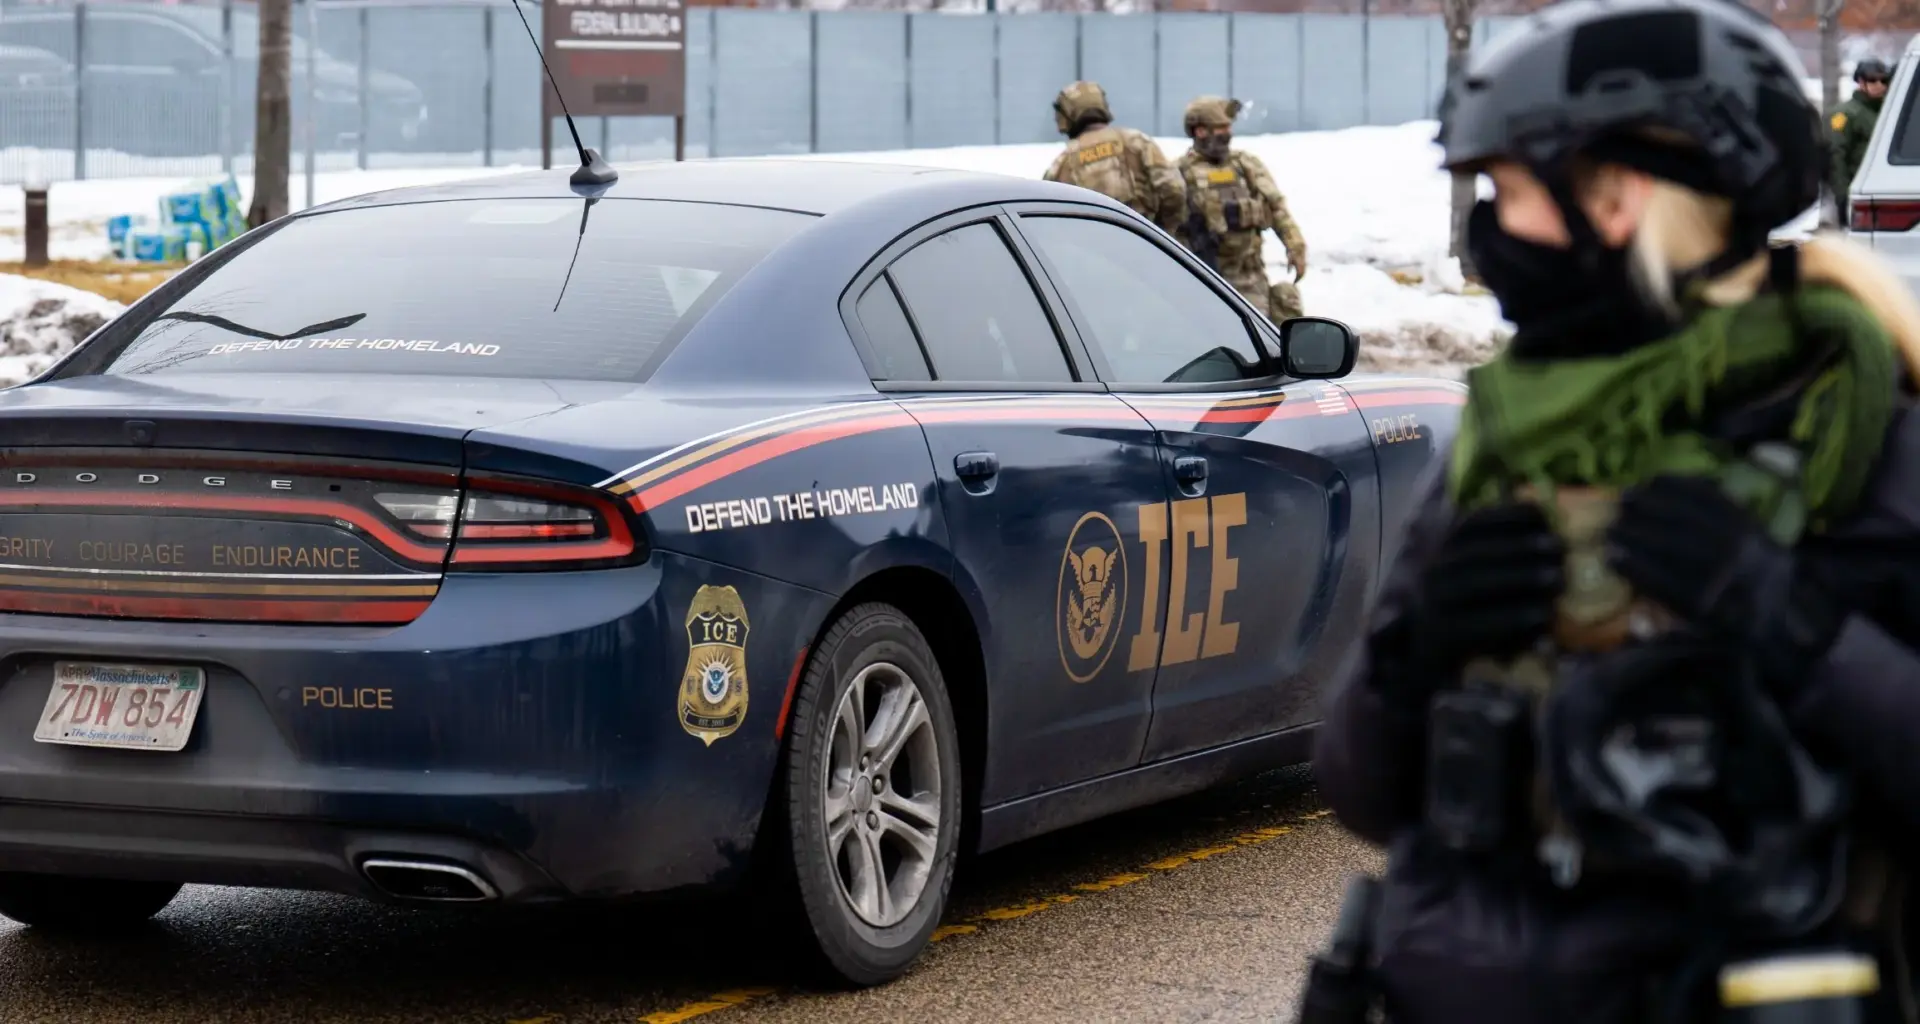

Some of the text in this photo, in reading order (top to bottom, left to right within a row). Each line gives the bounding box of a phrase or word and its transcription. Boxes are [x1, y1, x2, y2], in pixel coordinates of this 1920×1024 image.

[208, 338, 500, 356] DEFEND THE HOMELAND
[1371, 413, 1421, 446] POLICE
[17, 472, 293, 490] DODGE
[685, 482, 919, 533] DEFEND THE HOMELAND
[79, 541, 185, 564] COURAGE
[212, 545, 360, 568] ENDURANCE
[1127, 491, 1247, 673] ICE
[702, 621, 738, 643] ICE
[90, 666, 170, 685] Massachusetts
[50, 684, 193, 729] 7DW 854
[302, 686, 393, 710] POLICE
[71, 728, 86, 737] The
[87, 730, 109, 740] Spirit
[110, 732, 120, 740] of
